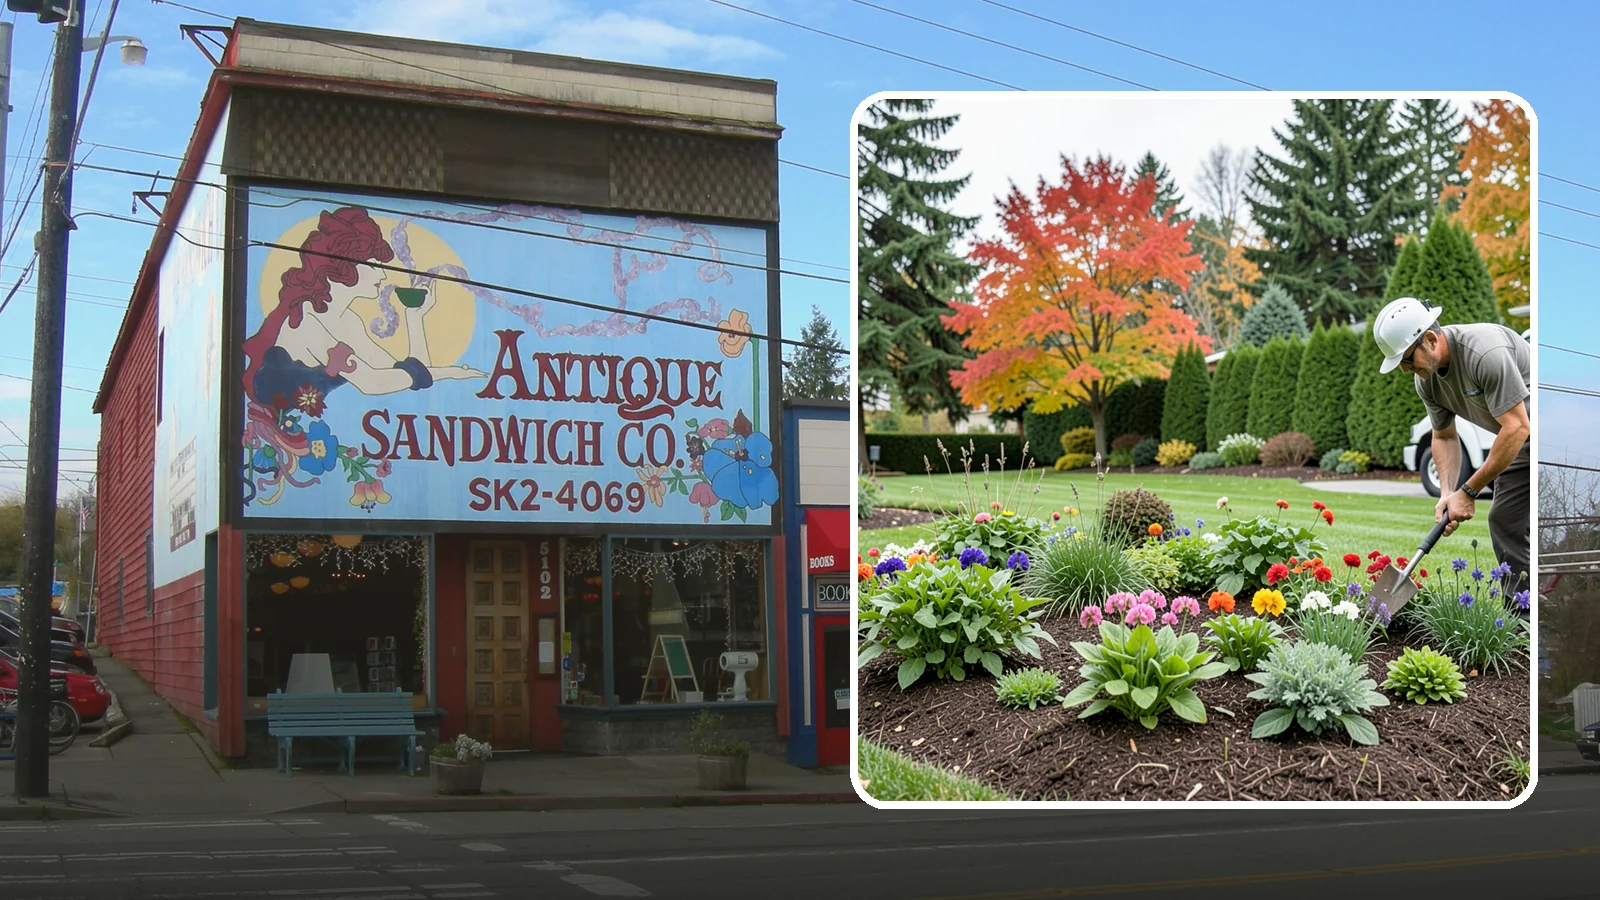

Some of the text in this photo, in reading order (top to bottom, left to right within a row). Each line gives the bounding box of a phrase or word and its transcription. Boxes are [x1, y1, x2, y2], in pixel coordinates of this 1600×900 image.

[476, 329, 723, 421] ANTIQUE
[361, 408, 685, 469] SANDWICH CO.
[468, 477, 646, 512] SK2-4069
[540, 541, 552, 599] 5102
[809, 555, 835, 569] BOOKS
